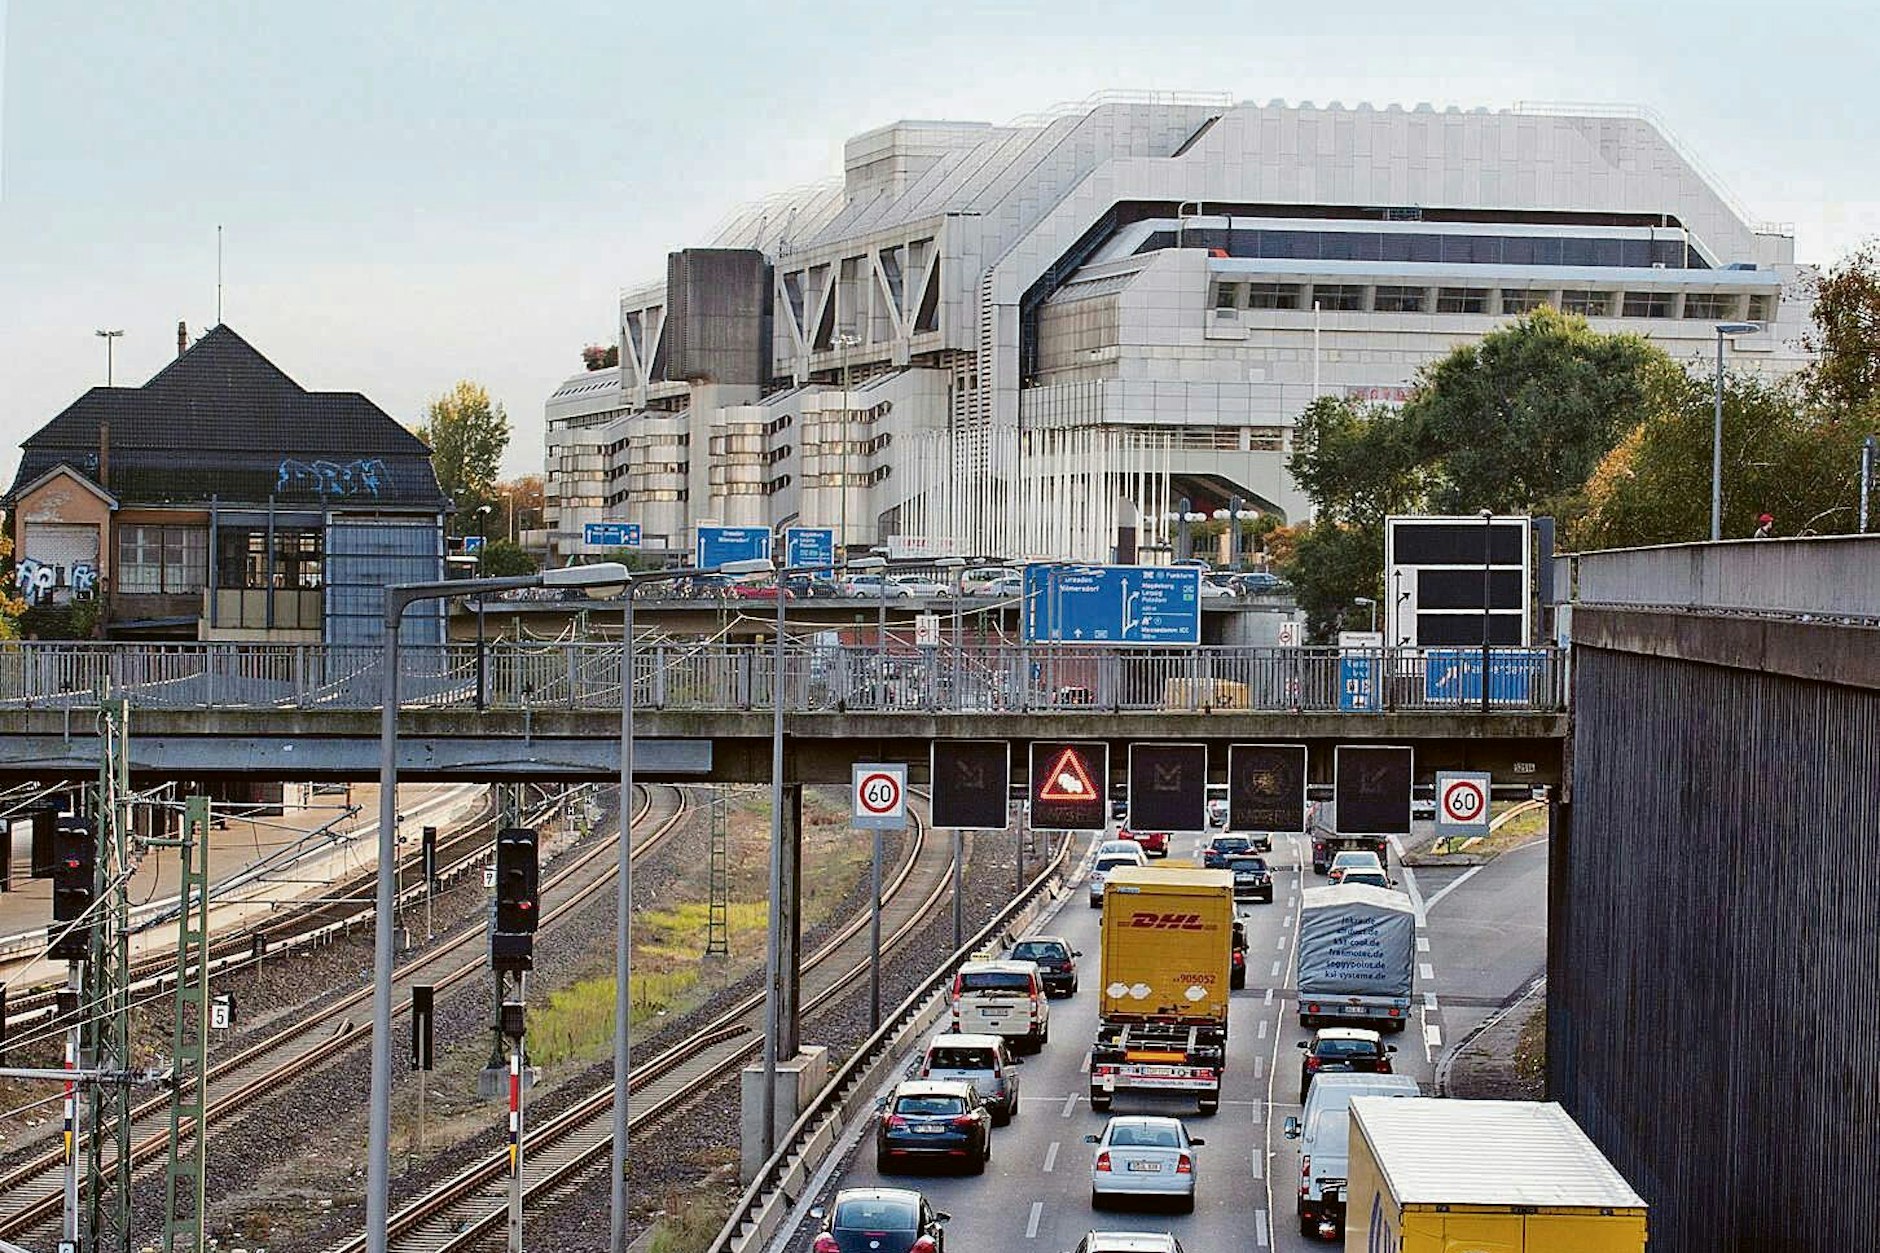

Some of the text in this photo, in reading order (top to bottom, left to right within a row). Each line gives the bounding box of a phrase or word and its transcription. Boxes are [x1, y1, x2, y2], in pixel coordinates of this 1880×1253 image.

[868, 784, 891, 803] 60
[1452, 792, 1476, 811] 60
[1131, 913, 1204, 930] DHL
[1180, 973, 1217, 985] 905052
[216, 1008, 225, 1025] 5
